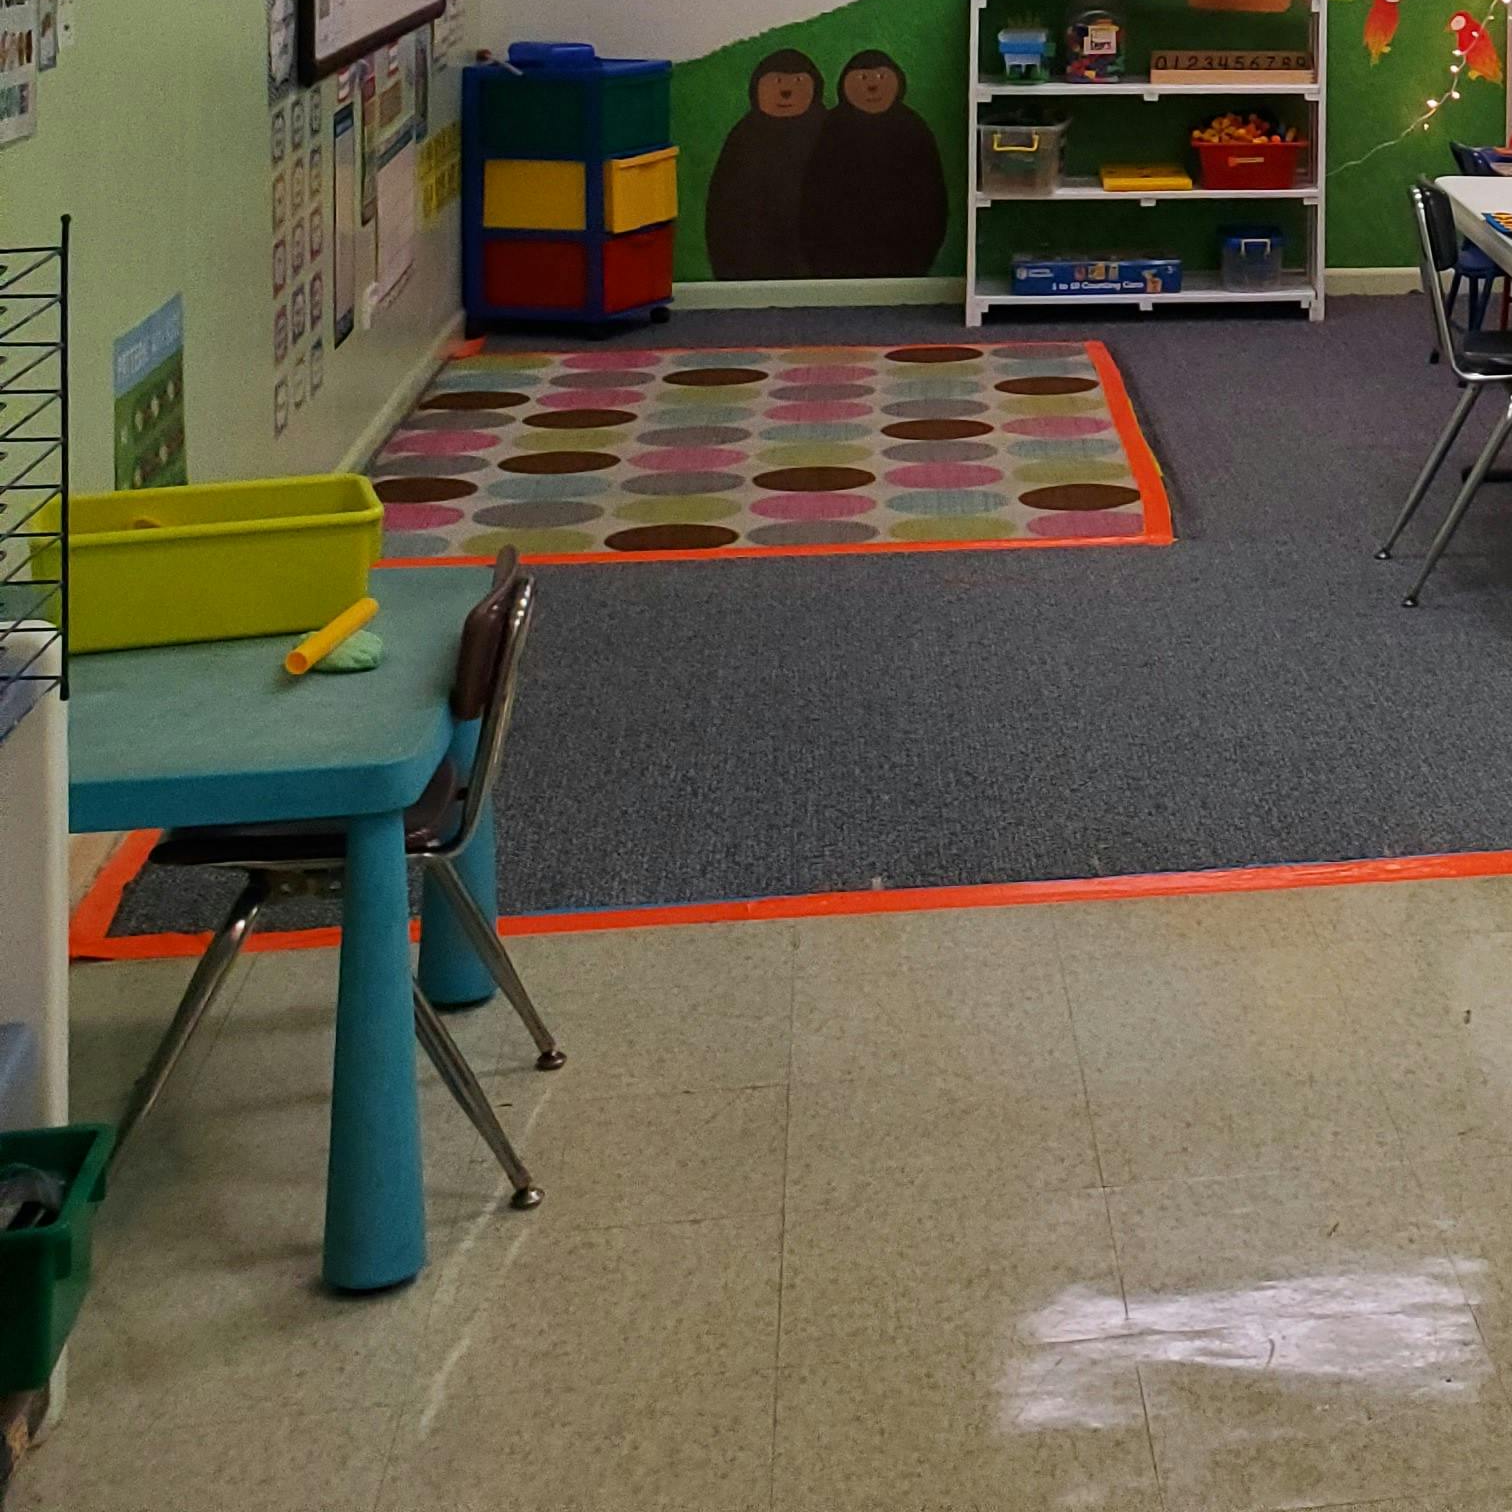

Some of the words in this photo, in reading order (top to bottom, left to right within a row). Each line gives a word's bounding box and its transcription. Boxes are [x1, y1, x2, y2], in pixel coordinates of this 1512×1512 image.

[1187, 56, 1198, 70] 2
[1204, 55, 1214, 69] 3
[1218, 55, 1229, 68] 4
[1235, 55, 1245, 69] 5
[1082, 282, 1121, 291] Counting
